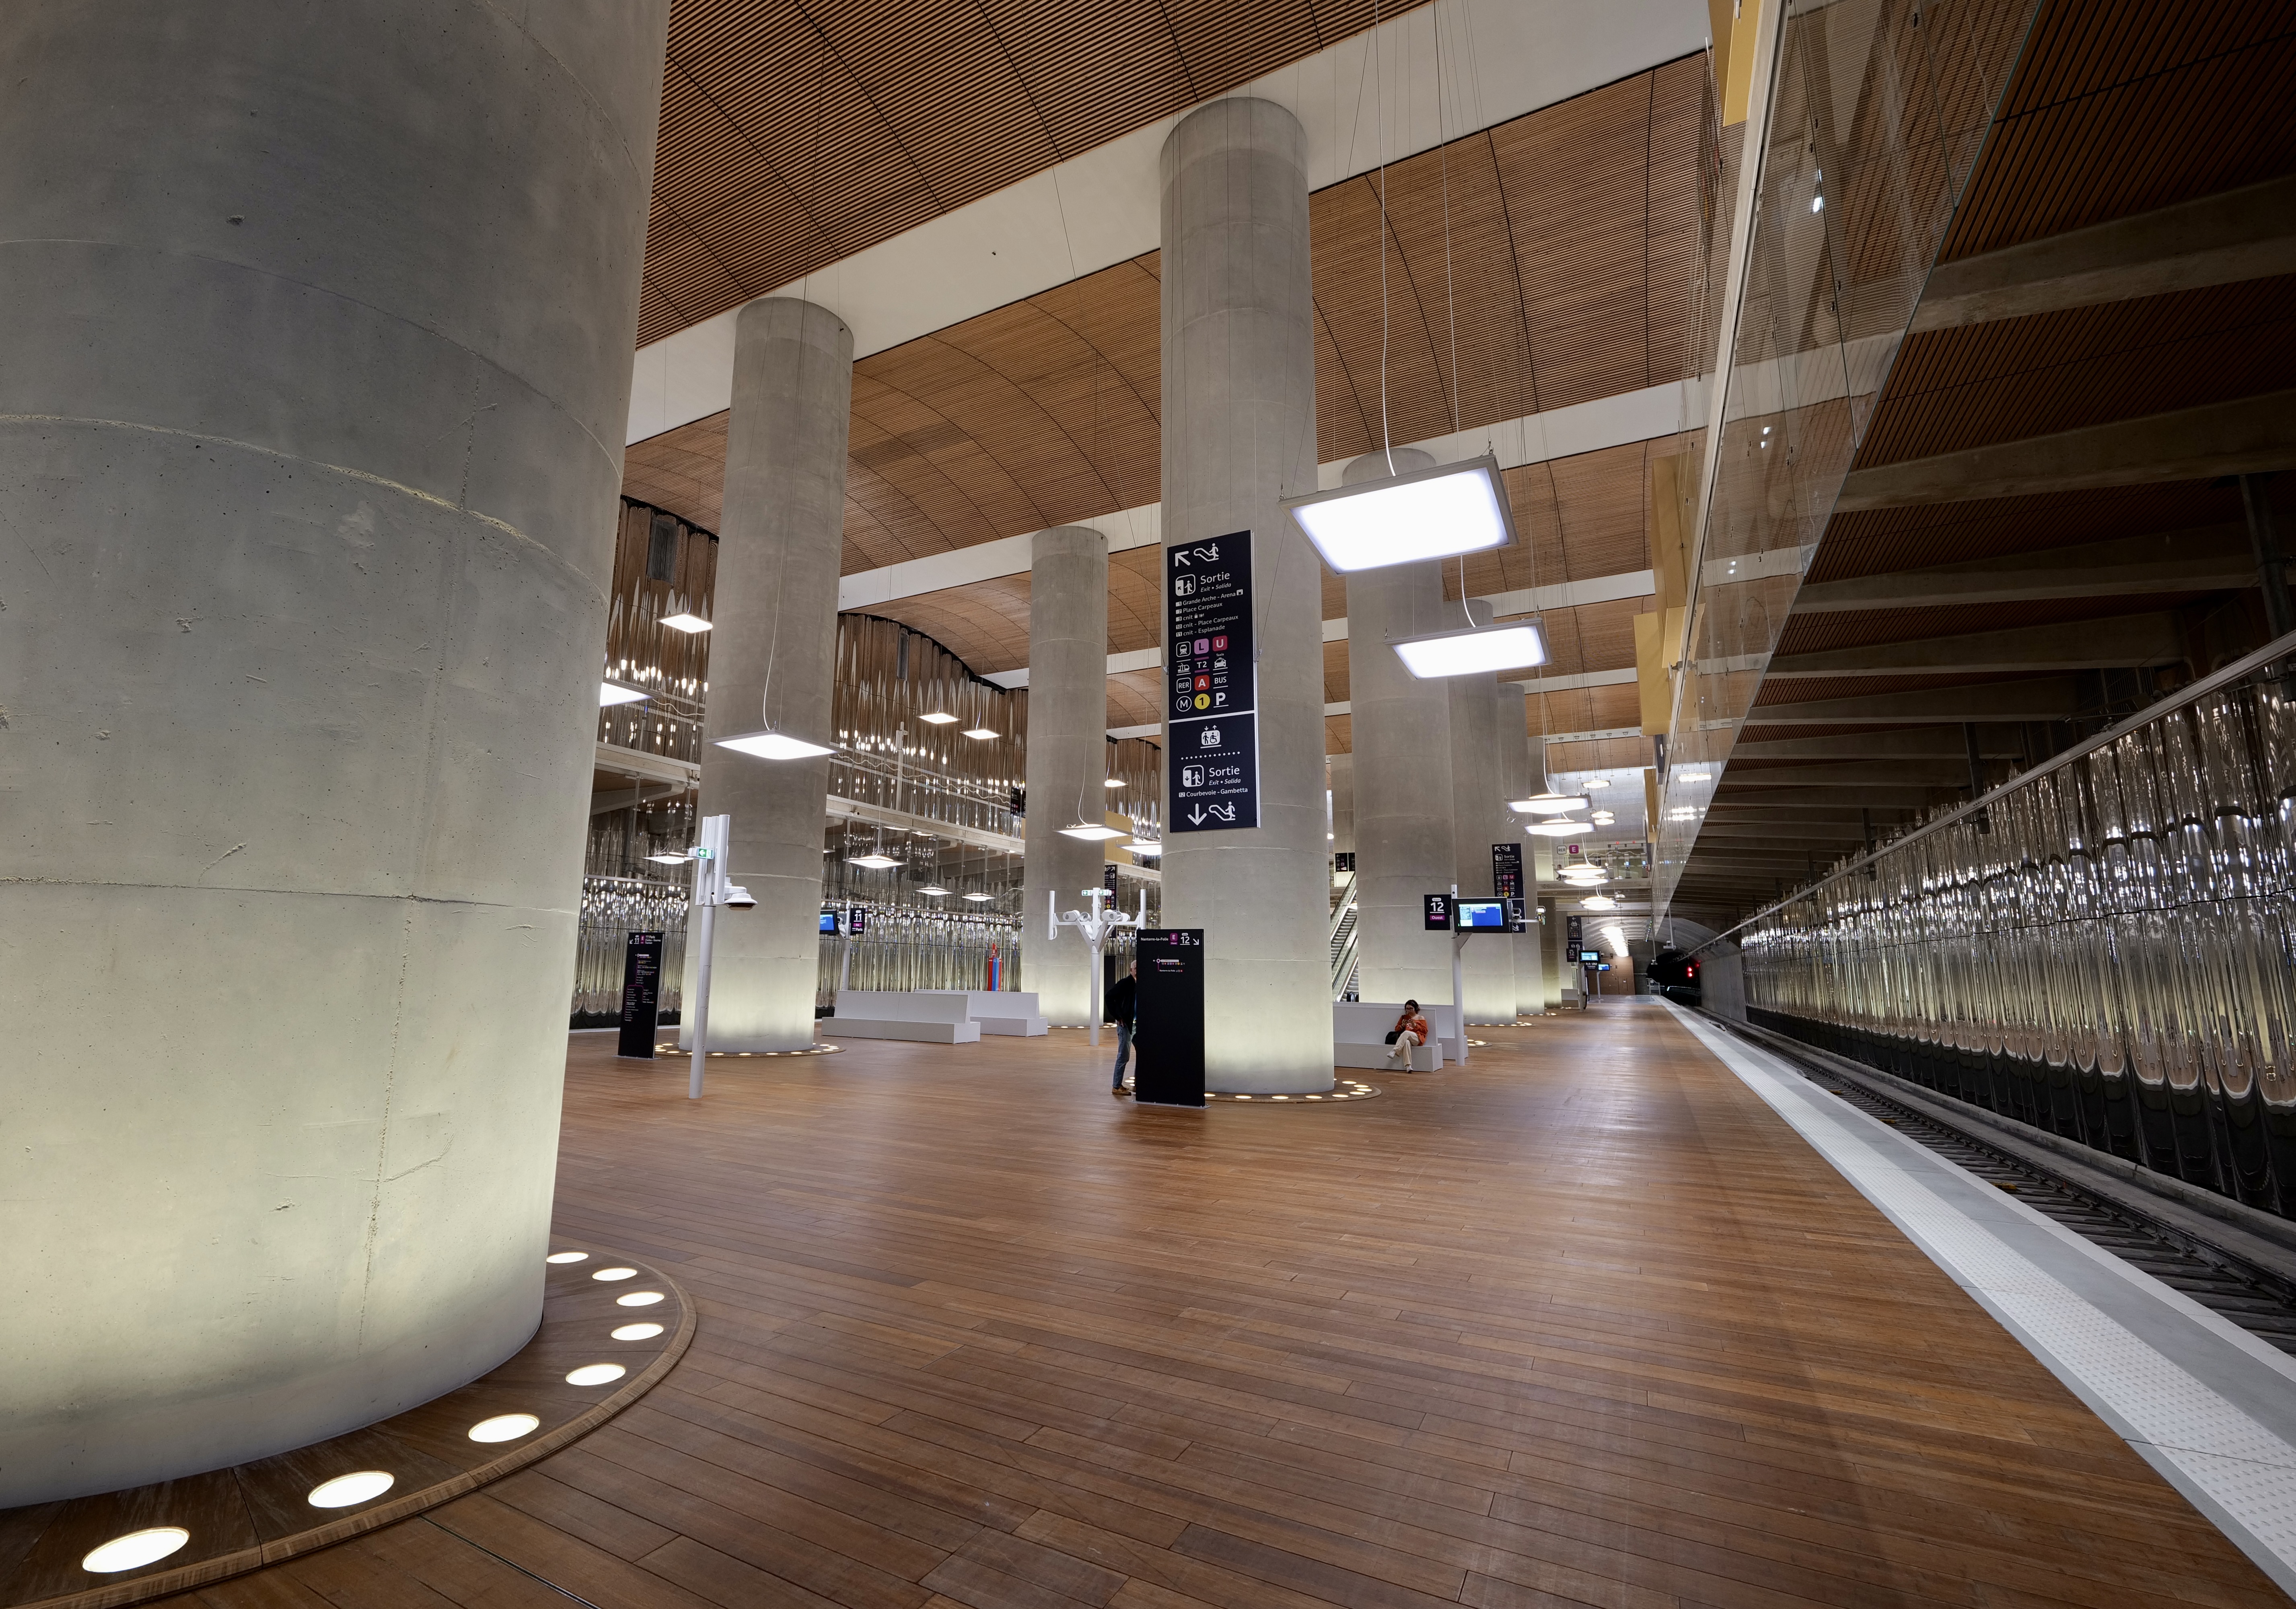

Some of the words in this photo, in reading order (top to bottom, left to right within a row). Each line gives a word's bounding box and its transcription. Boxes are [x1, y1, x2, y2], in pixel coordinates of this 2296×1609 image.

[1200, 572, 1230, 584] Sortie
[1198, 625, 1225, 634] Esplanade
[1216, 639, 1224, 648] U
[1198, 678, 1206, 687] A
[1180, 700, 1188, 708] M
[1216, 692, 1226, 706] P
[1209, 766, 1240, 777] Sortie
[1430, 902, 1444, 911] 12
